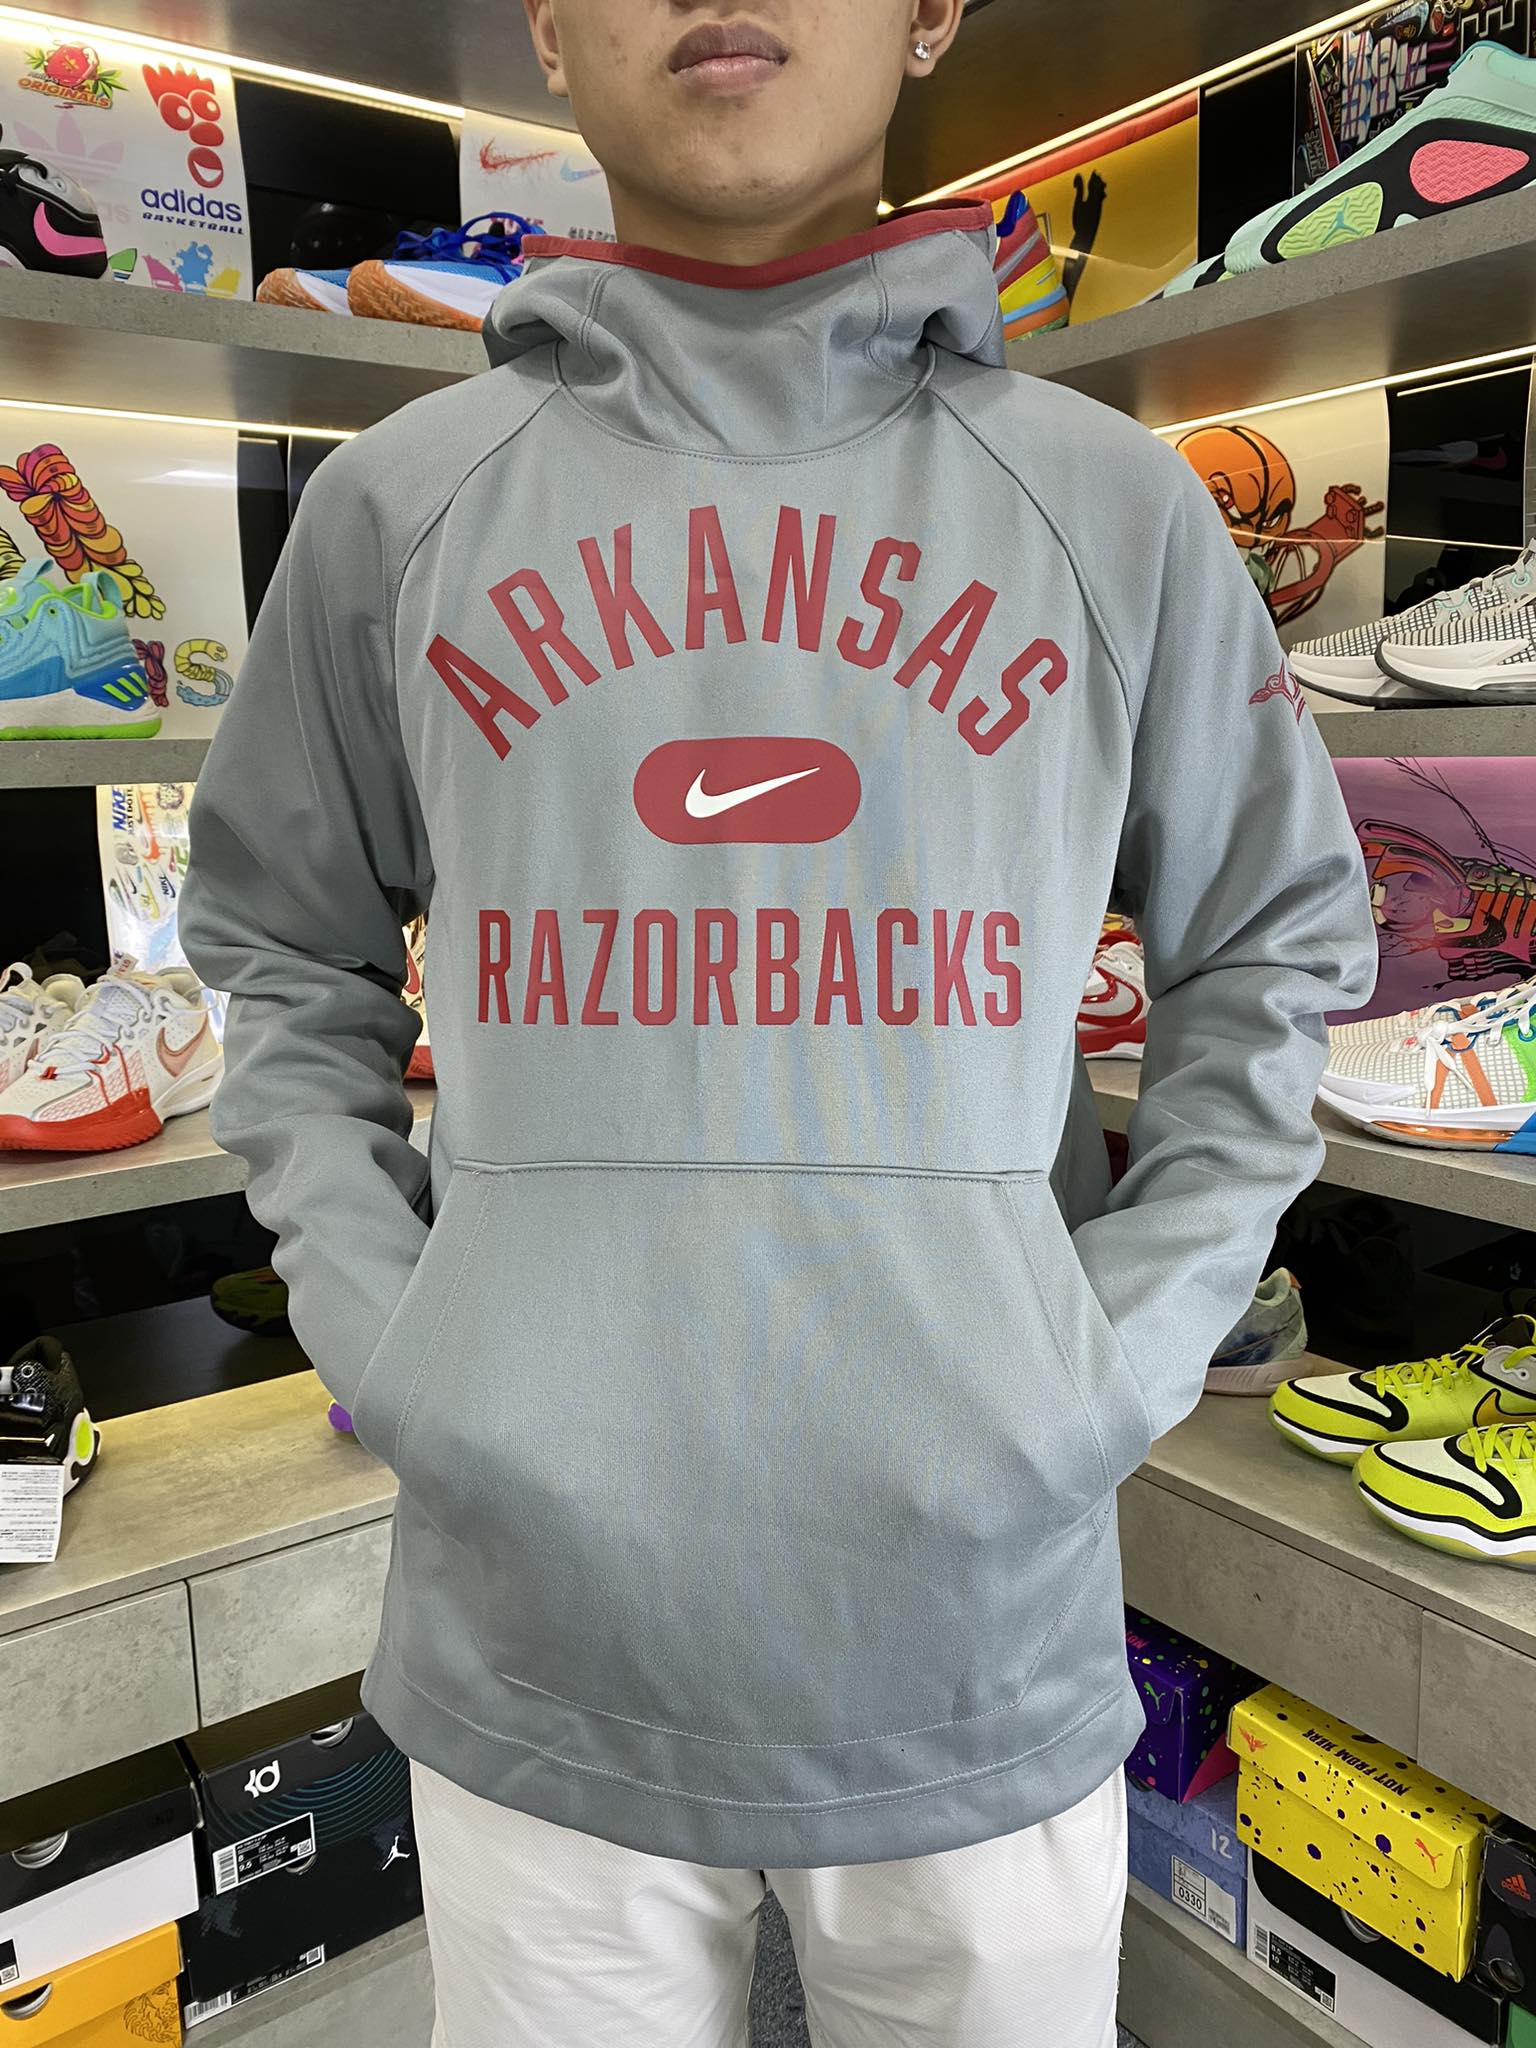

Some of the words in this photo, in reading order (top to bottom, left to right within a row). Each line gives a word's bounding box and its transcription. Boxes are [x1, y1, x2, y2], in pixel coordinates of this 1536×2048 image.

[18, 77, 111, 108] ORIGINALS
[141, 188, 242, 222] adidas
[142, 212, 244, 235] BASKETBALL
[426, 505, 1069, 761] ARKANSAS
[478, 908, 1022, 1027] RAZORBACKS
[1302, 1728, 1338, 1752] HERE
[1334, 1748, 1377, 1776] FROM
[1373, 1772, 1412, 1797] NOT
[1211, 1828, 1232, 1859] 12
[1179, 1886, 1203, 1911] 0330
